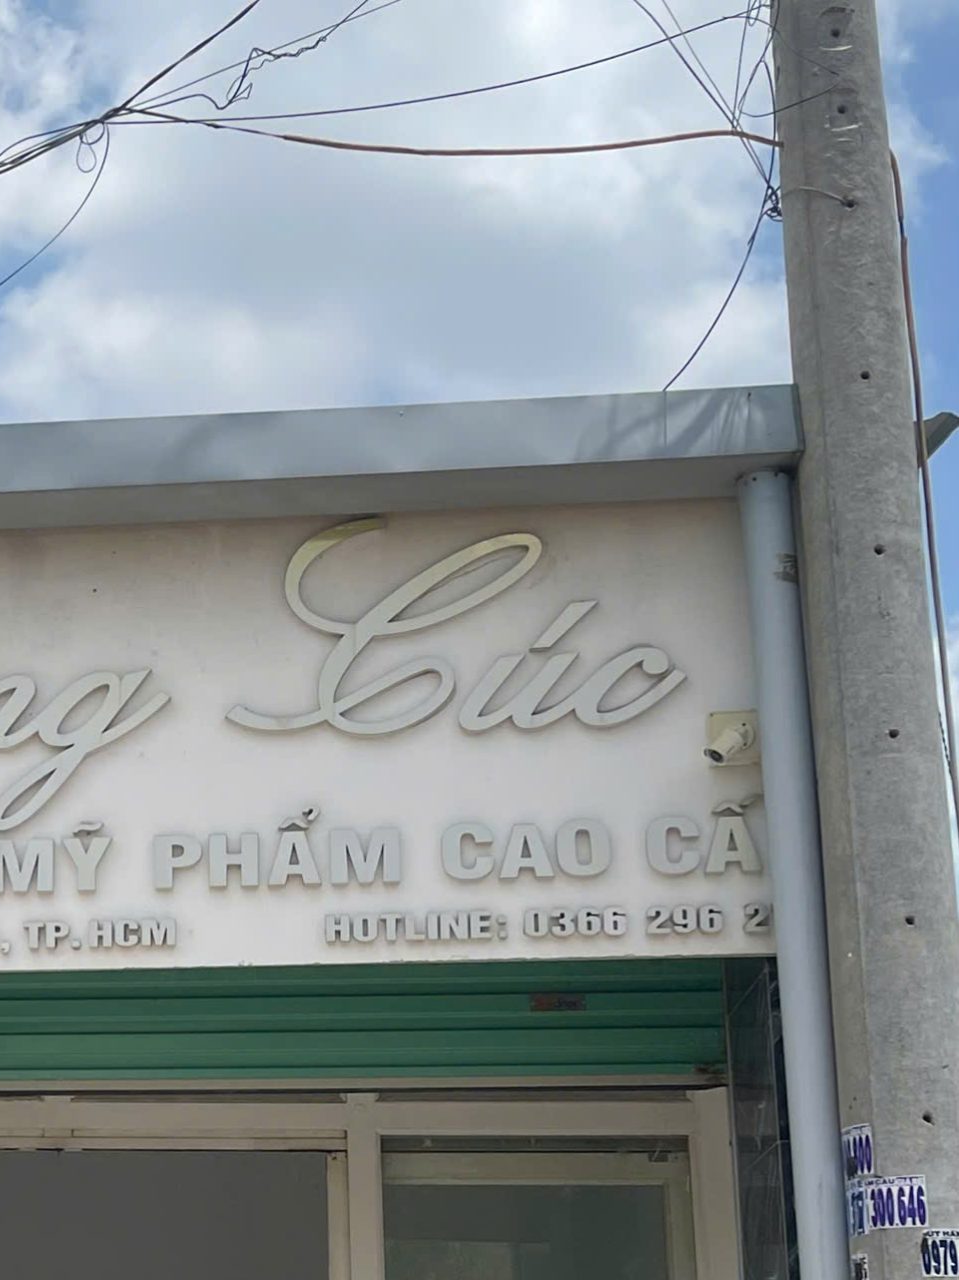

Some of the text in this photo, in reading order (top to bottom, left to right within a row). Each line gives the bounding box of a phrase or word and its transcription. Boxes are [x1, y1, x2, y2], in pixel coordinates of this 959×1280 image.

[226, 514, 688, 736] Cúc
[153, 806, 401, 891] PHẨM
[441, 820, 612, 881] CAO
[325, 909, 508, 944] HOTLINE:
[523, 906, 628, 938] 0366
[645, 904, 723, 936] 296
[743, 902, 774, 934] 2
